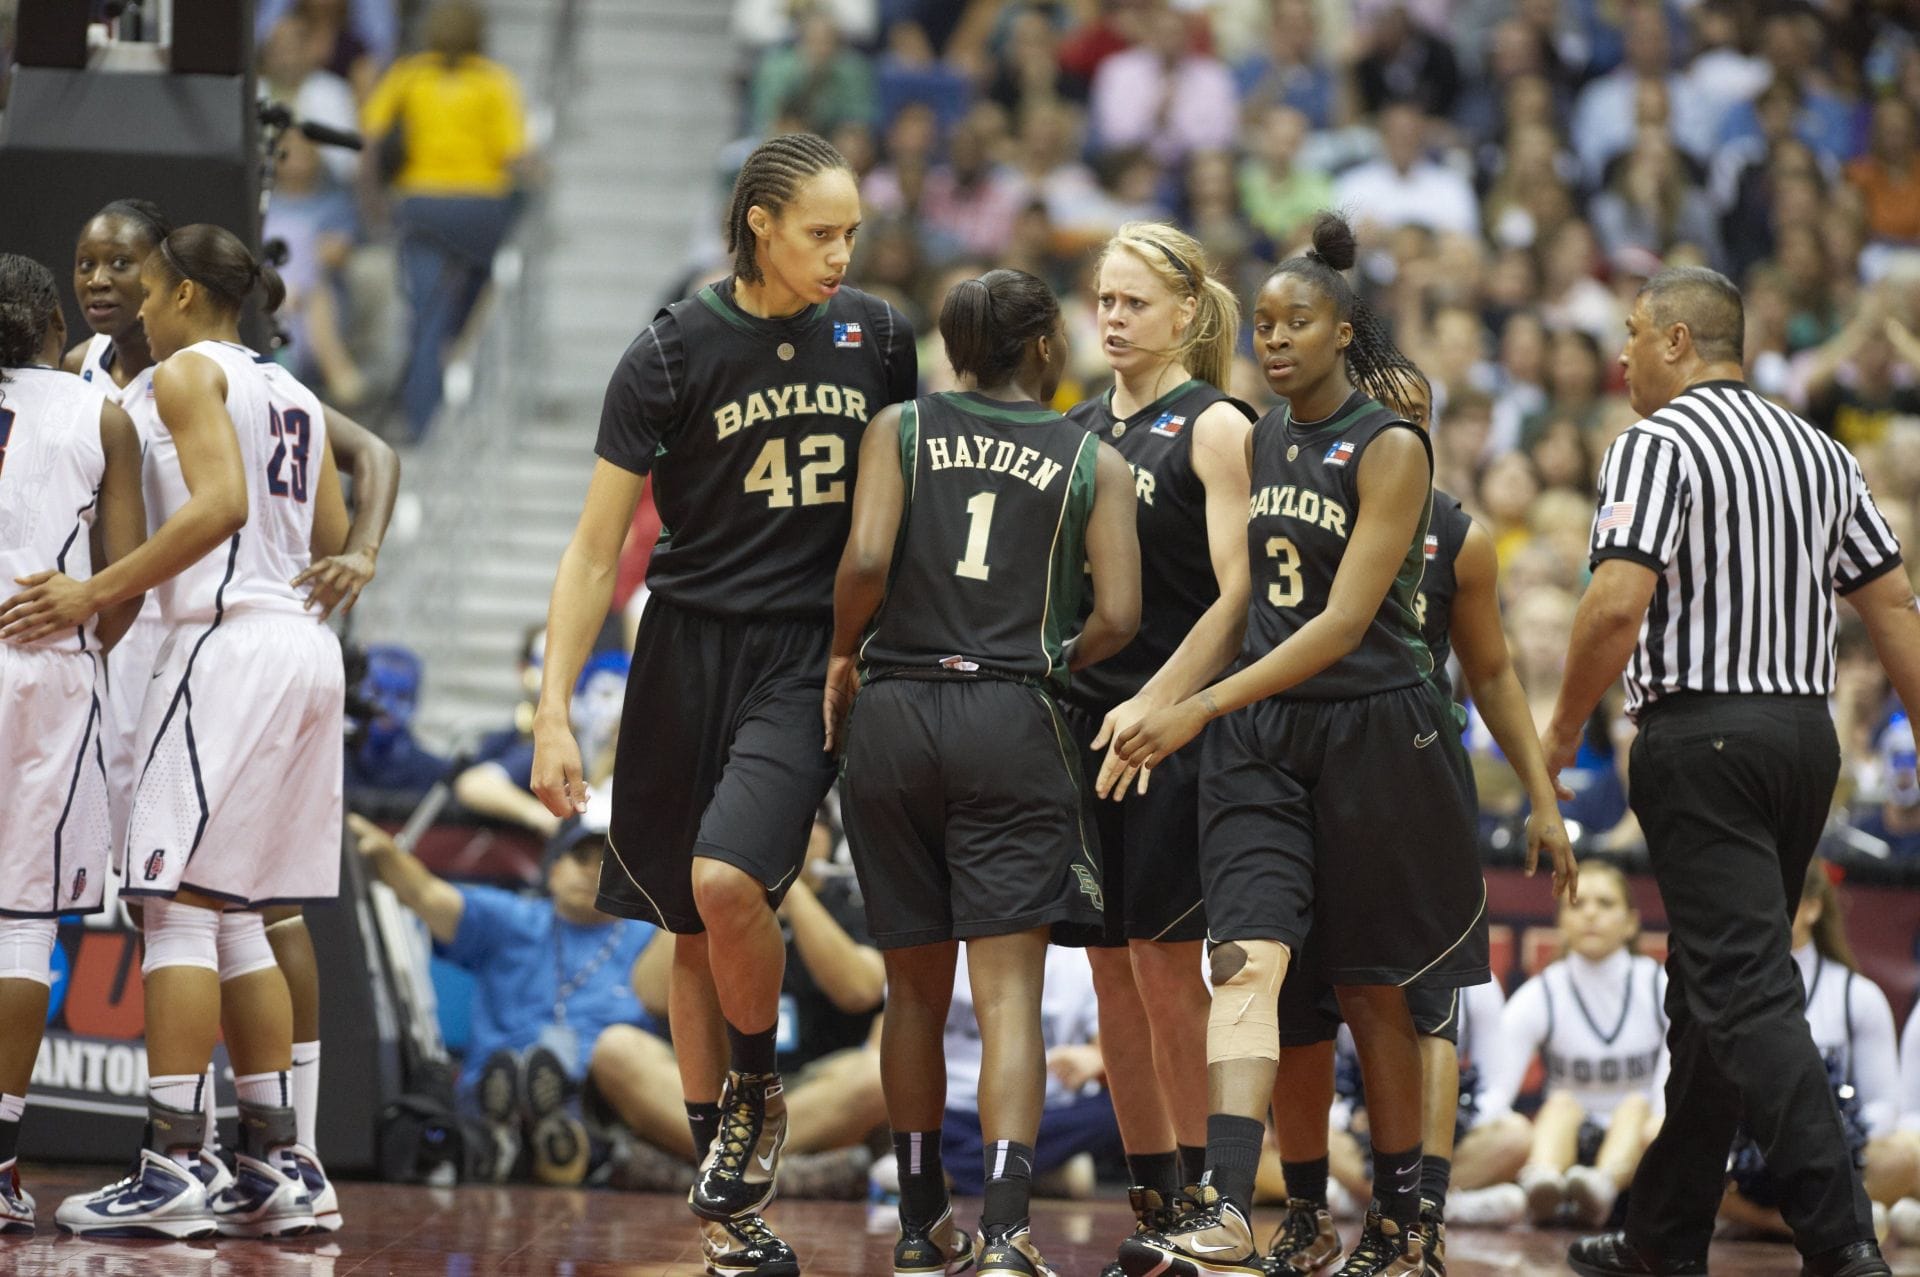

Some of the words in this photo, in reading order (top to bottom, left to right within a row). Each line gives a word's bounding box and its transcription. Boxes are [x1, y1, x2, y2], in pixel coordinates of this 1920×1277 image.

[713, 384, 869, 442] BAYLOR
[267, 401, 310, 504] 23
[743, 434, 846, 509] 42
[926, 435, 1063, 491] HAYDEN
[955, 490, 997, 582] 1
[1265, 536, 1304, 607] 3
